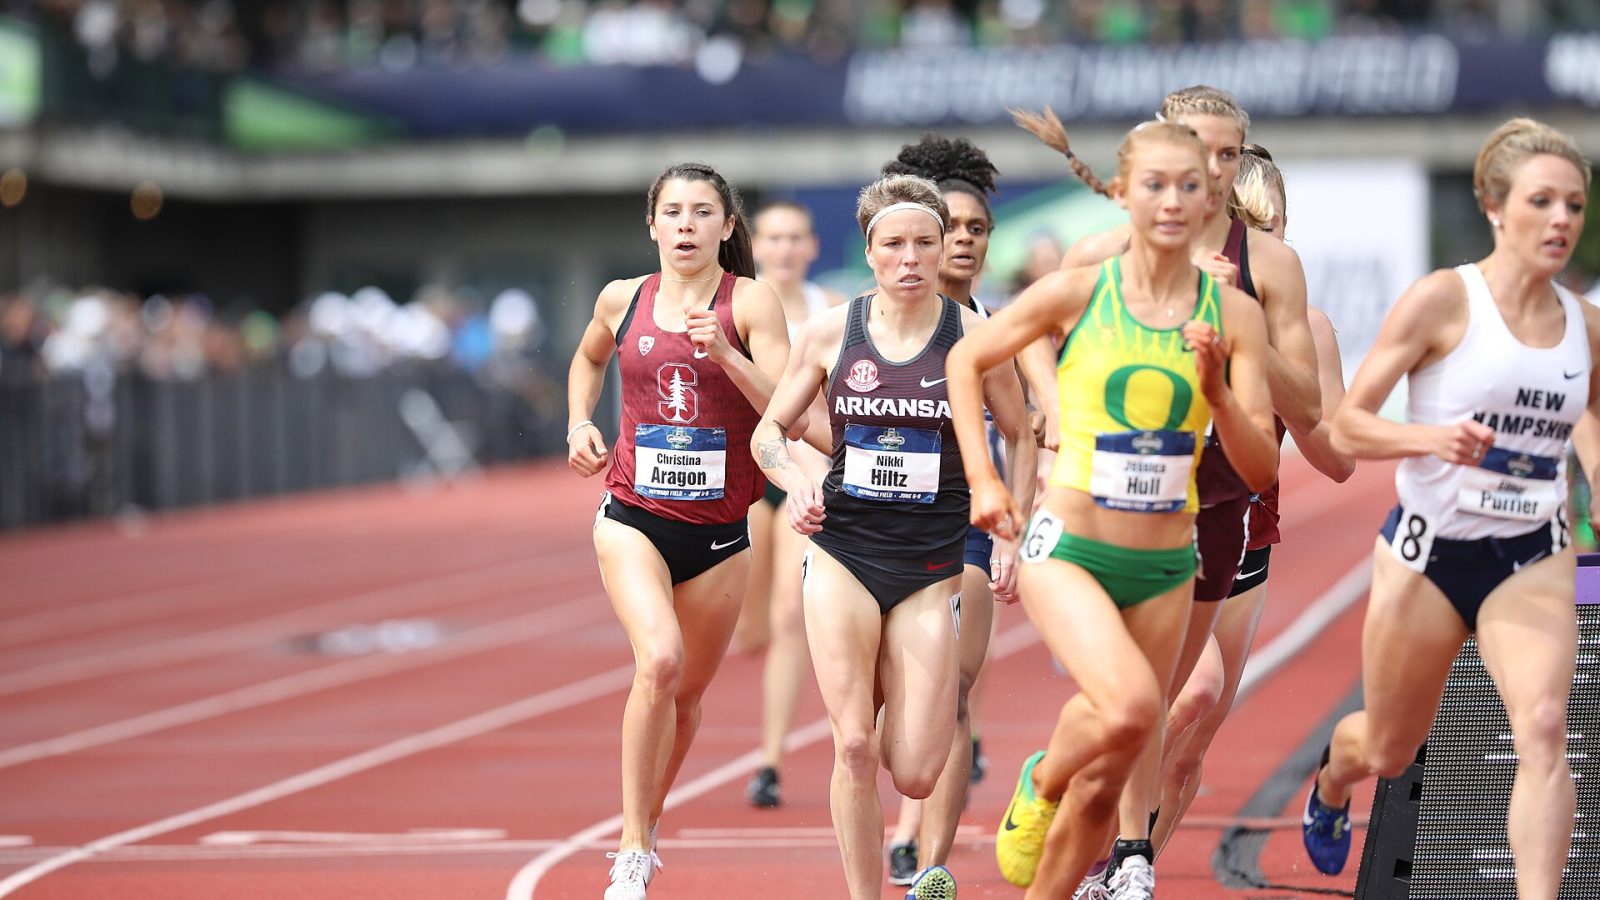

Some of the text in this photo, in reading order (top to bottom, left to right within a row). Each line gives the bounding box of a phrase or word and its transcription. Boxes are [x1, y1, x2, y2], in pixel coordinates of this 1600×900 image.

[853, 362, 876, 383] SEC
[1515, 388, 1566, 411] NEW
[657, 453, 702, 466] Christina
[876, 455, 904, 467] Nikki
[651, 466, 707, 487] Aragon
[871, 469, 908, 487] Hiltz
[1127, 477, 1160, 495] Hull
[1402, 514, 1427, 562] 8
